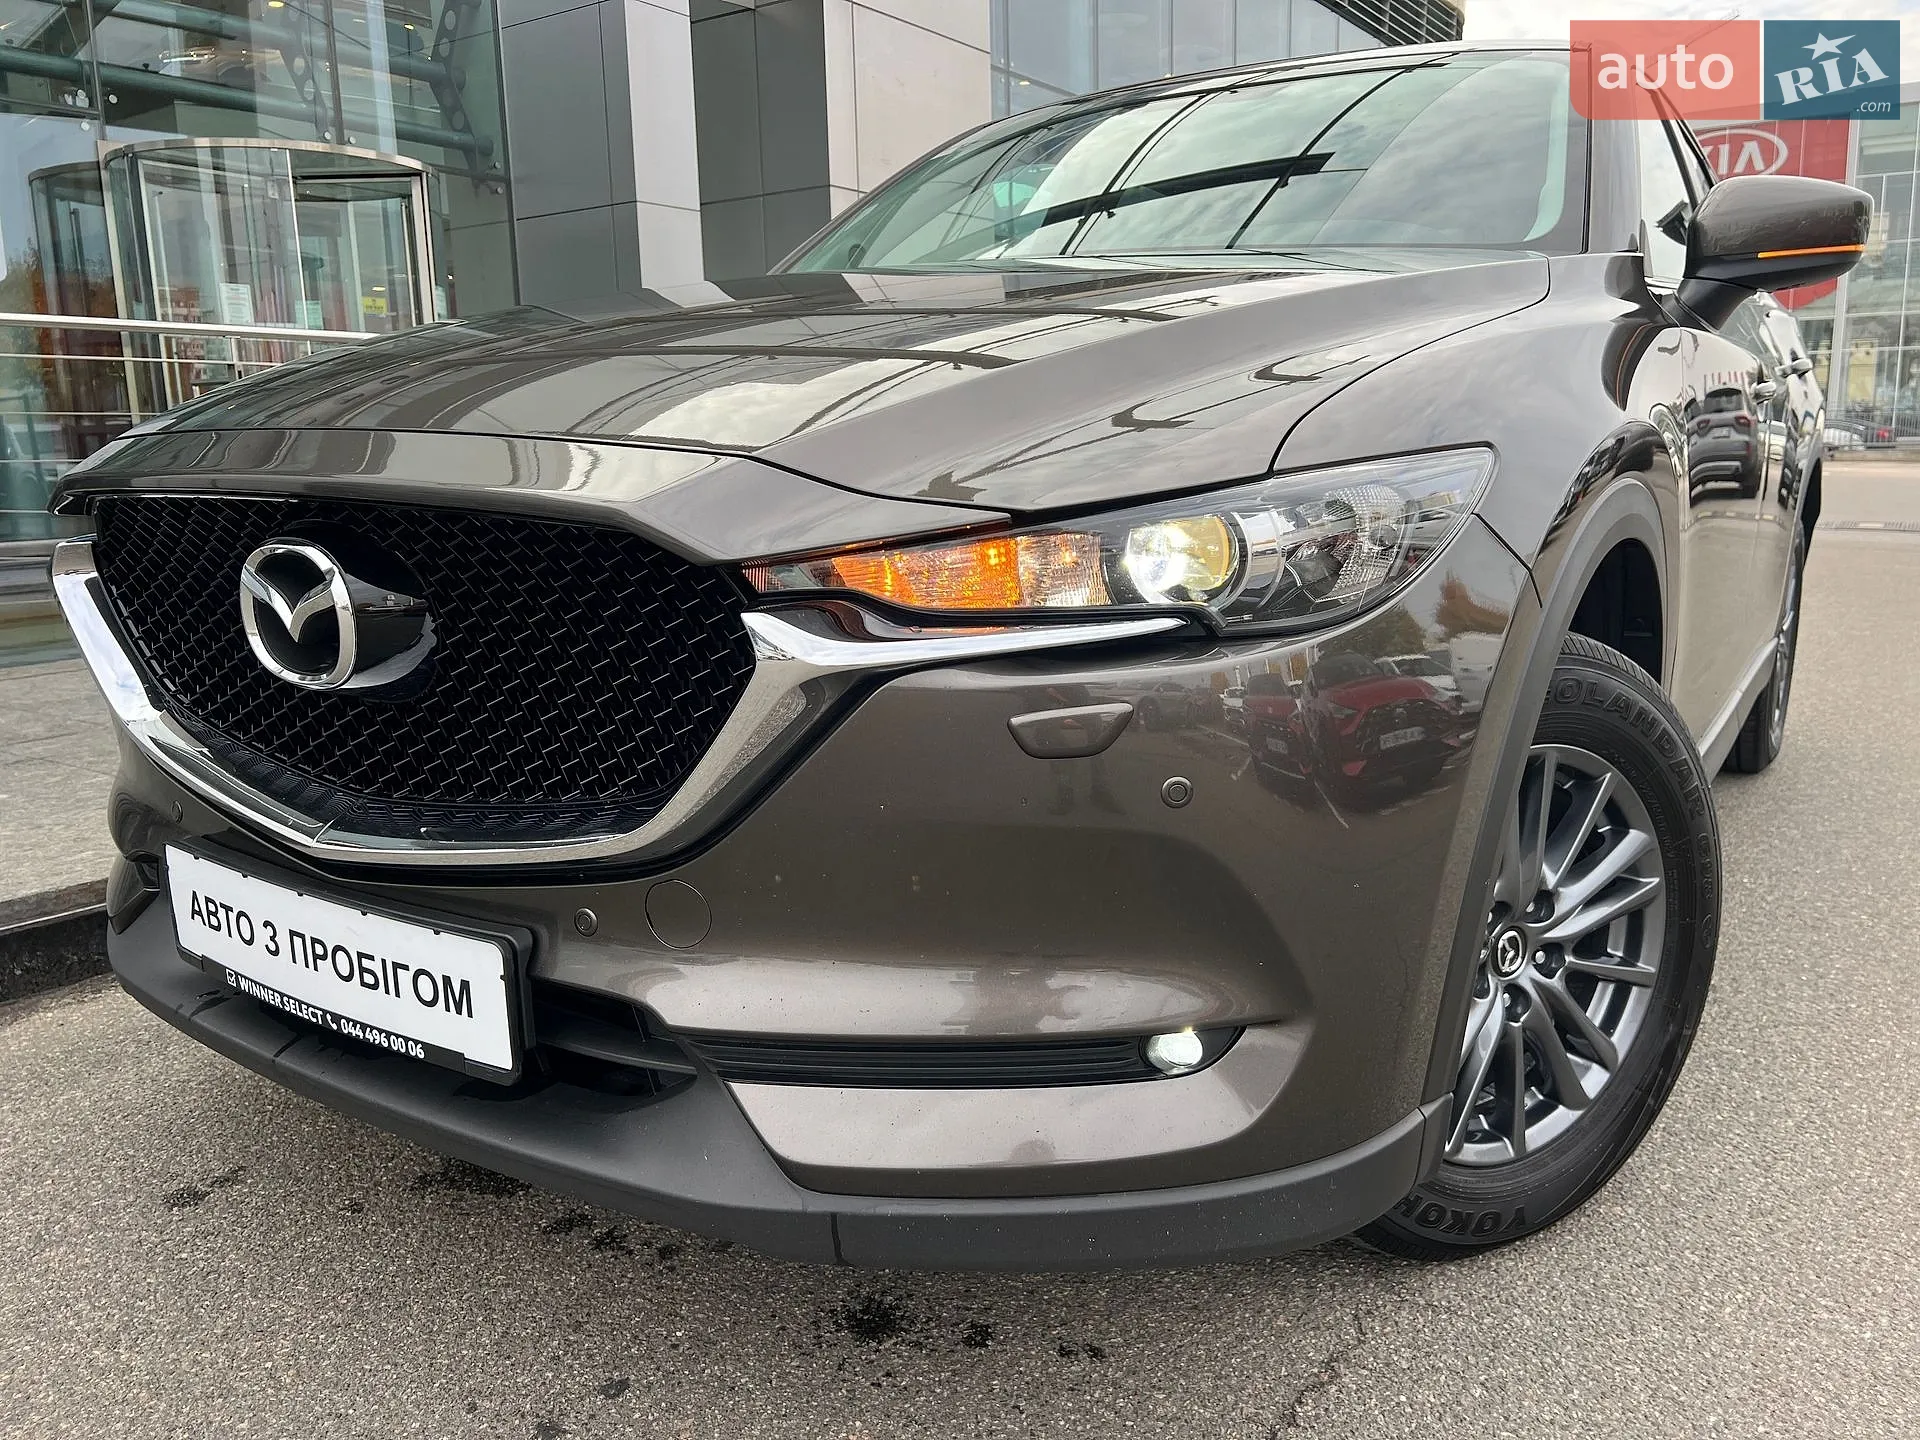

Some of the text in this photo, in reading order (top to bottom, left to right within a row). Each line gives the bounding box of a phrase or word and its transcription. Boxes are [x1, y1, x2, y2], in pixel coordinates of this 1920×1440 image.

[1543, 677, 1705, 816] OLANDAR
[191, 890, 474, 1019] АВТО З ПРОБІГОМ
[238, 975, 425, 1059] WINNER SELECT 044 496 00 06
